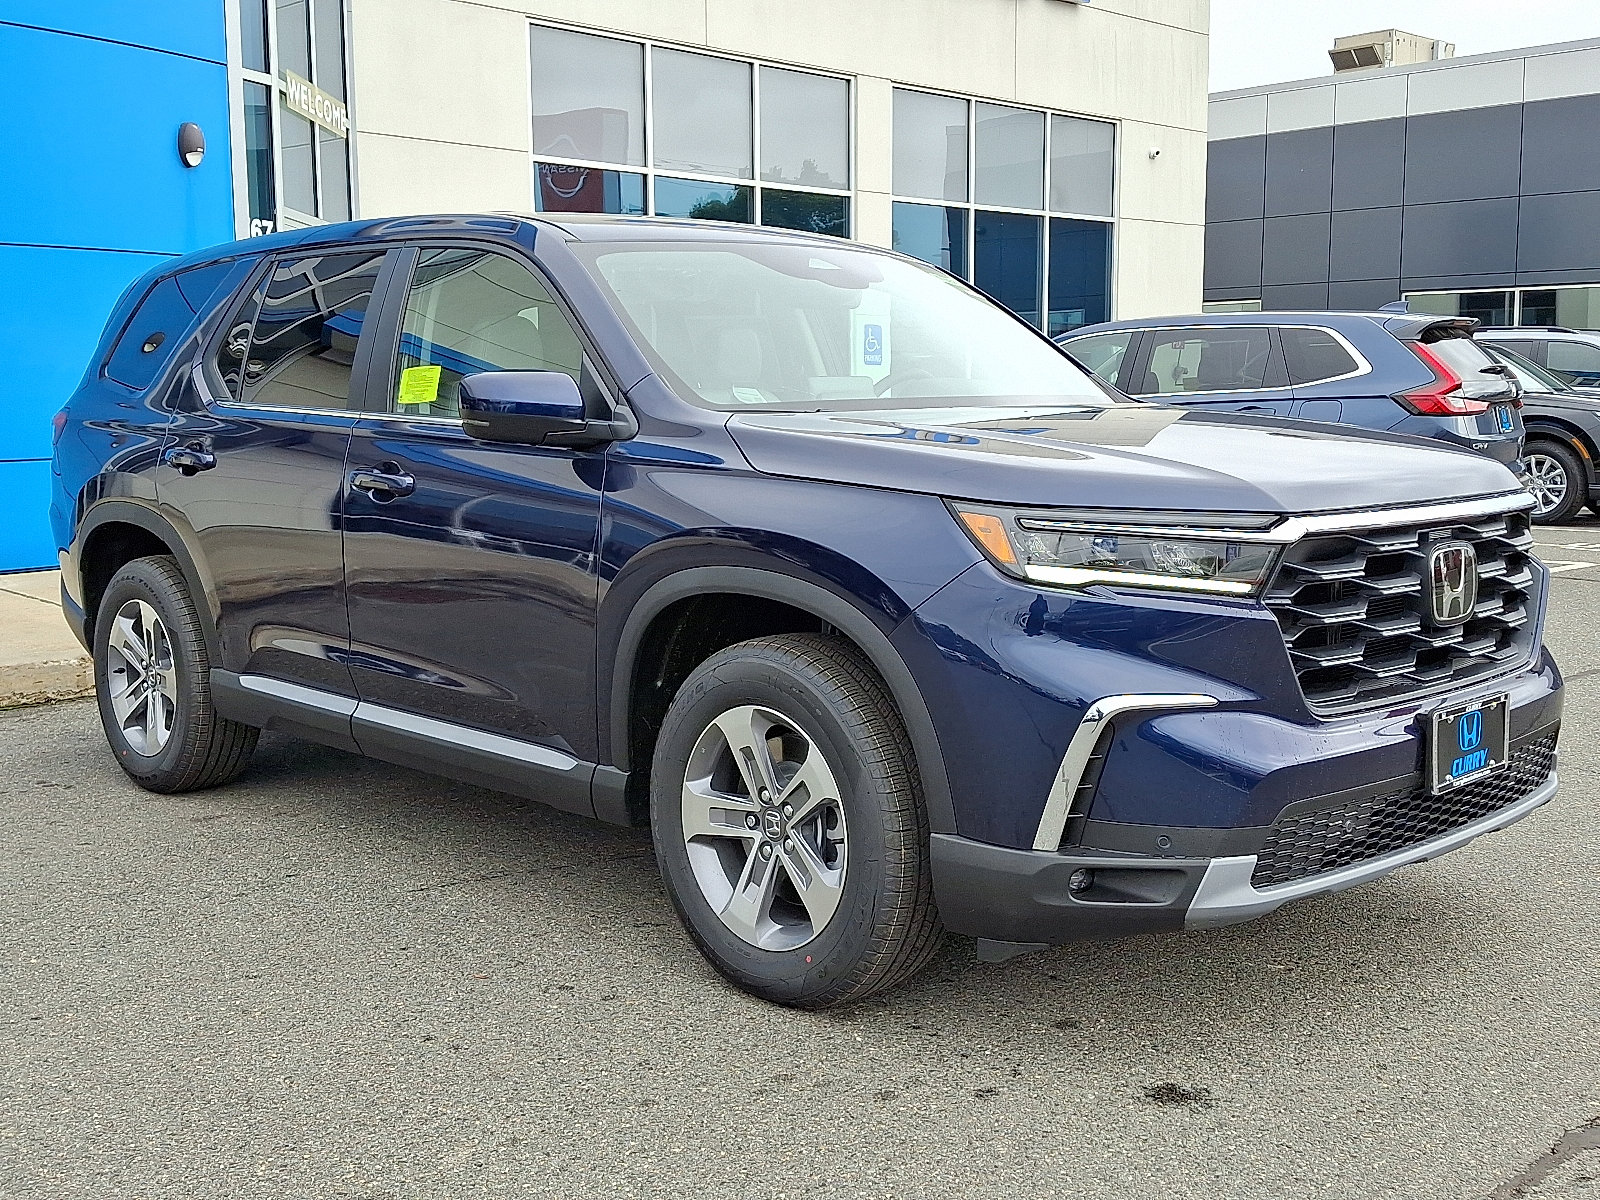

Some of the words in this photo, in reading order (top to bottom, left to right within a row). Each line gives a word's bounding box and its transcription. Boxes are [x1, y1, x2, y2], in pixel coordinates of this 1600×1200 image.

[287, 75, 346, 132] WELCOME
[251, 218, 273, 238] 67
[1452, 748, 1488, 777] CURRY
